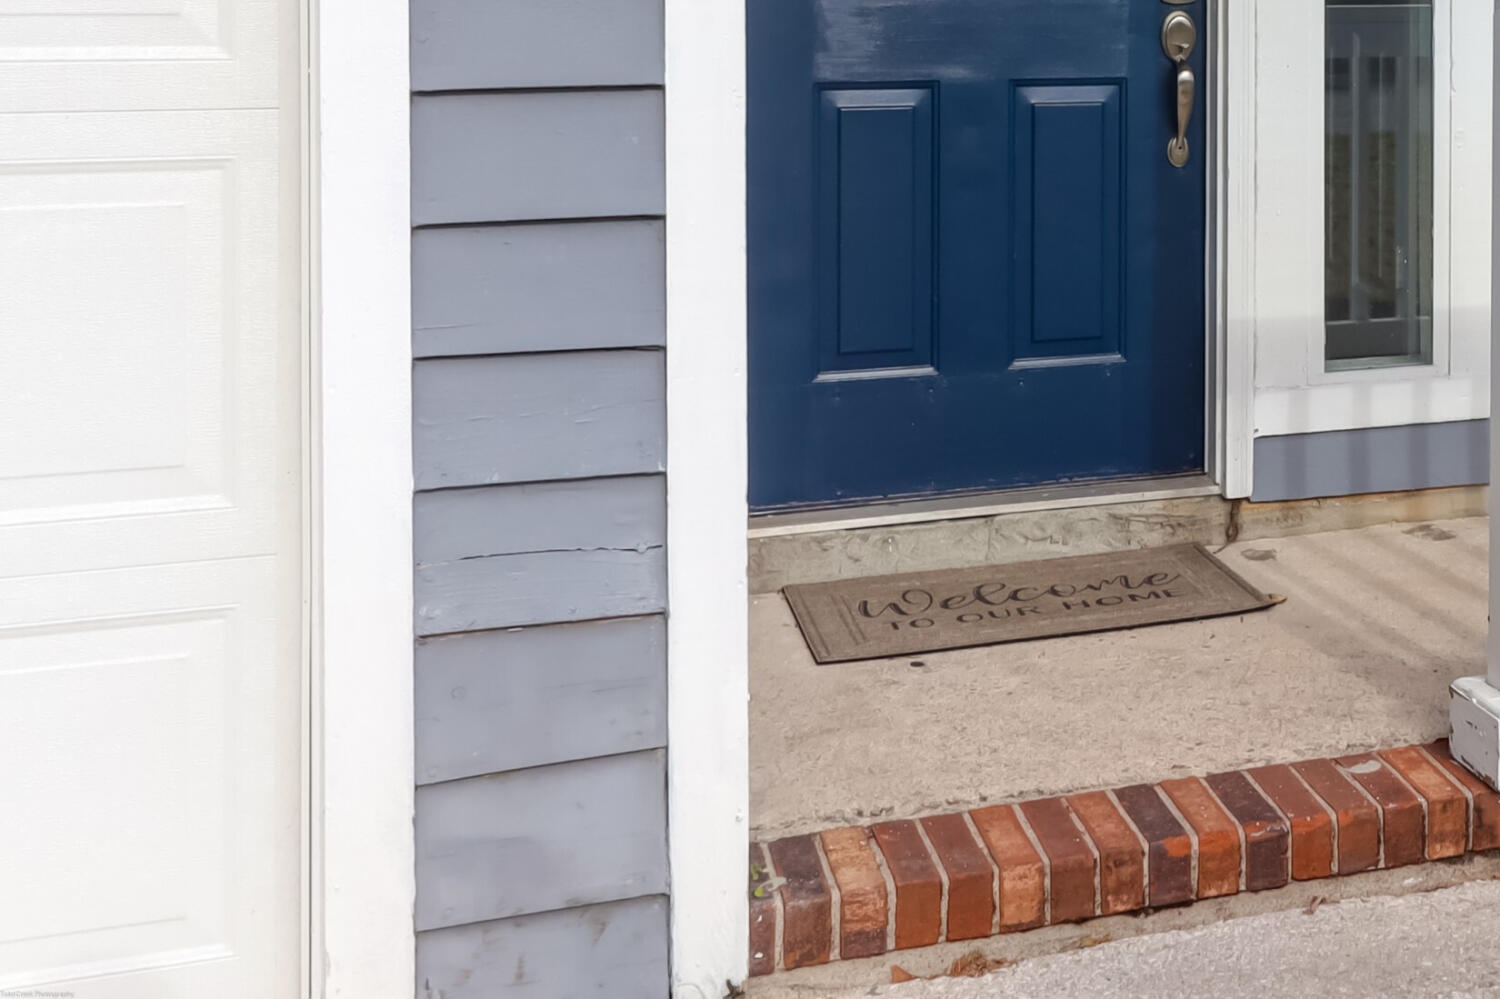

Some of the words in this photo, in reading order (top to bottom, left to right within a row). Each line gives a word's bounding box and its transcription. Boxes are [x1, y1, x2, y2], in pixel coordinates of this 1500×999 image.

[857, 572, 1181, 618] Welcome
[886, 617, 935, 631] TO
[956, 605, 1041, 623] OUR
[1061, 588, 1188, 611] HOME
